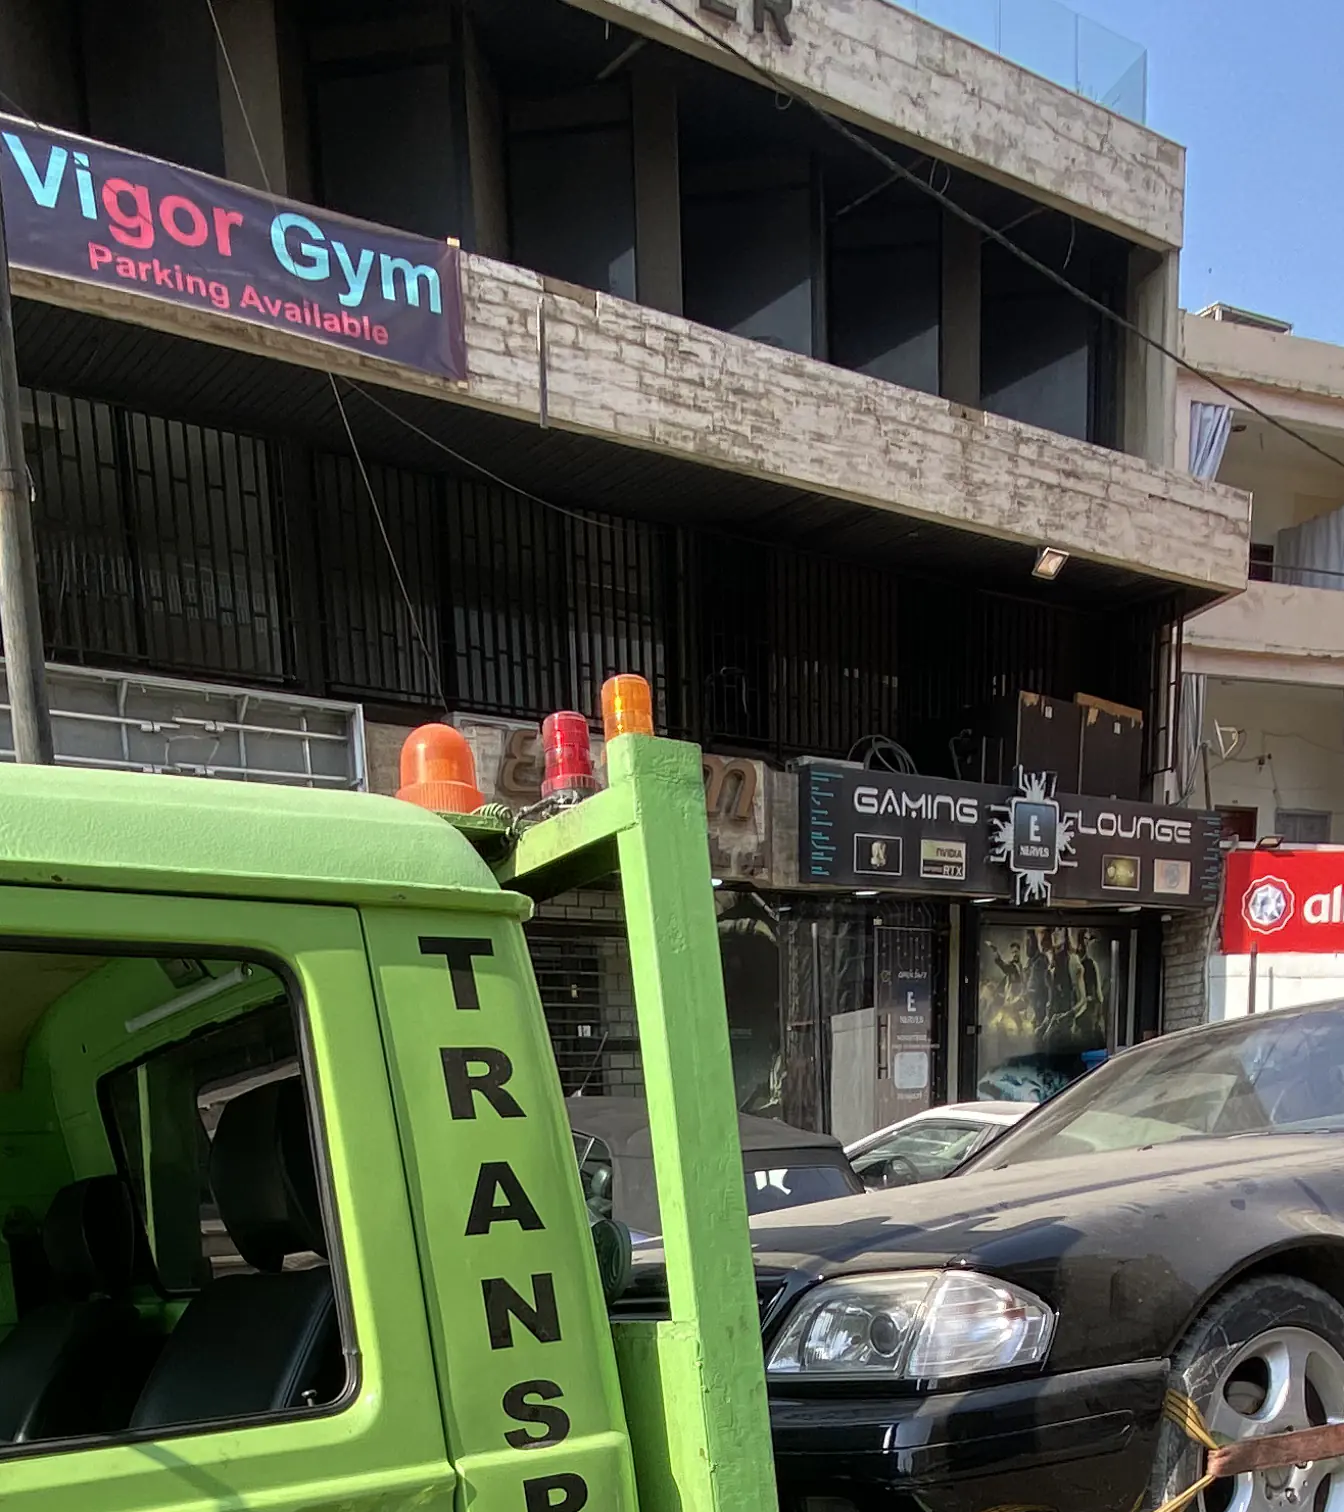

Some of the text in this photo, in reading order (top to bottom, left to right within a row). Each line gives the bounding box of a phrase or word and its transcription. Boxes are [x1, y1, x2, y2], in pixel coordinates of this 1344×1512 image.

[2, 131, 443, 314] Vigor Gym
[88, 242, 390, 347] Parking Available
[854, 787, 1192, 844] GAMING LOUNGE
[1029, 814, 1041, 842] E
[936, 847, 962, 859] NVIDIA
[943, 865, 963, 876] RTX
